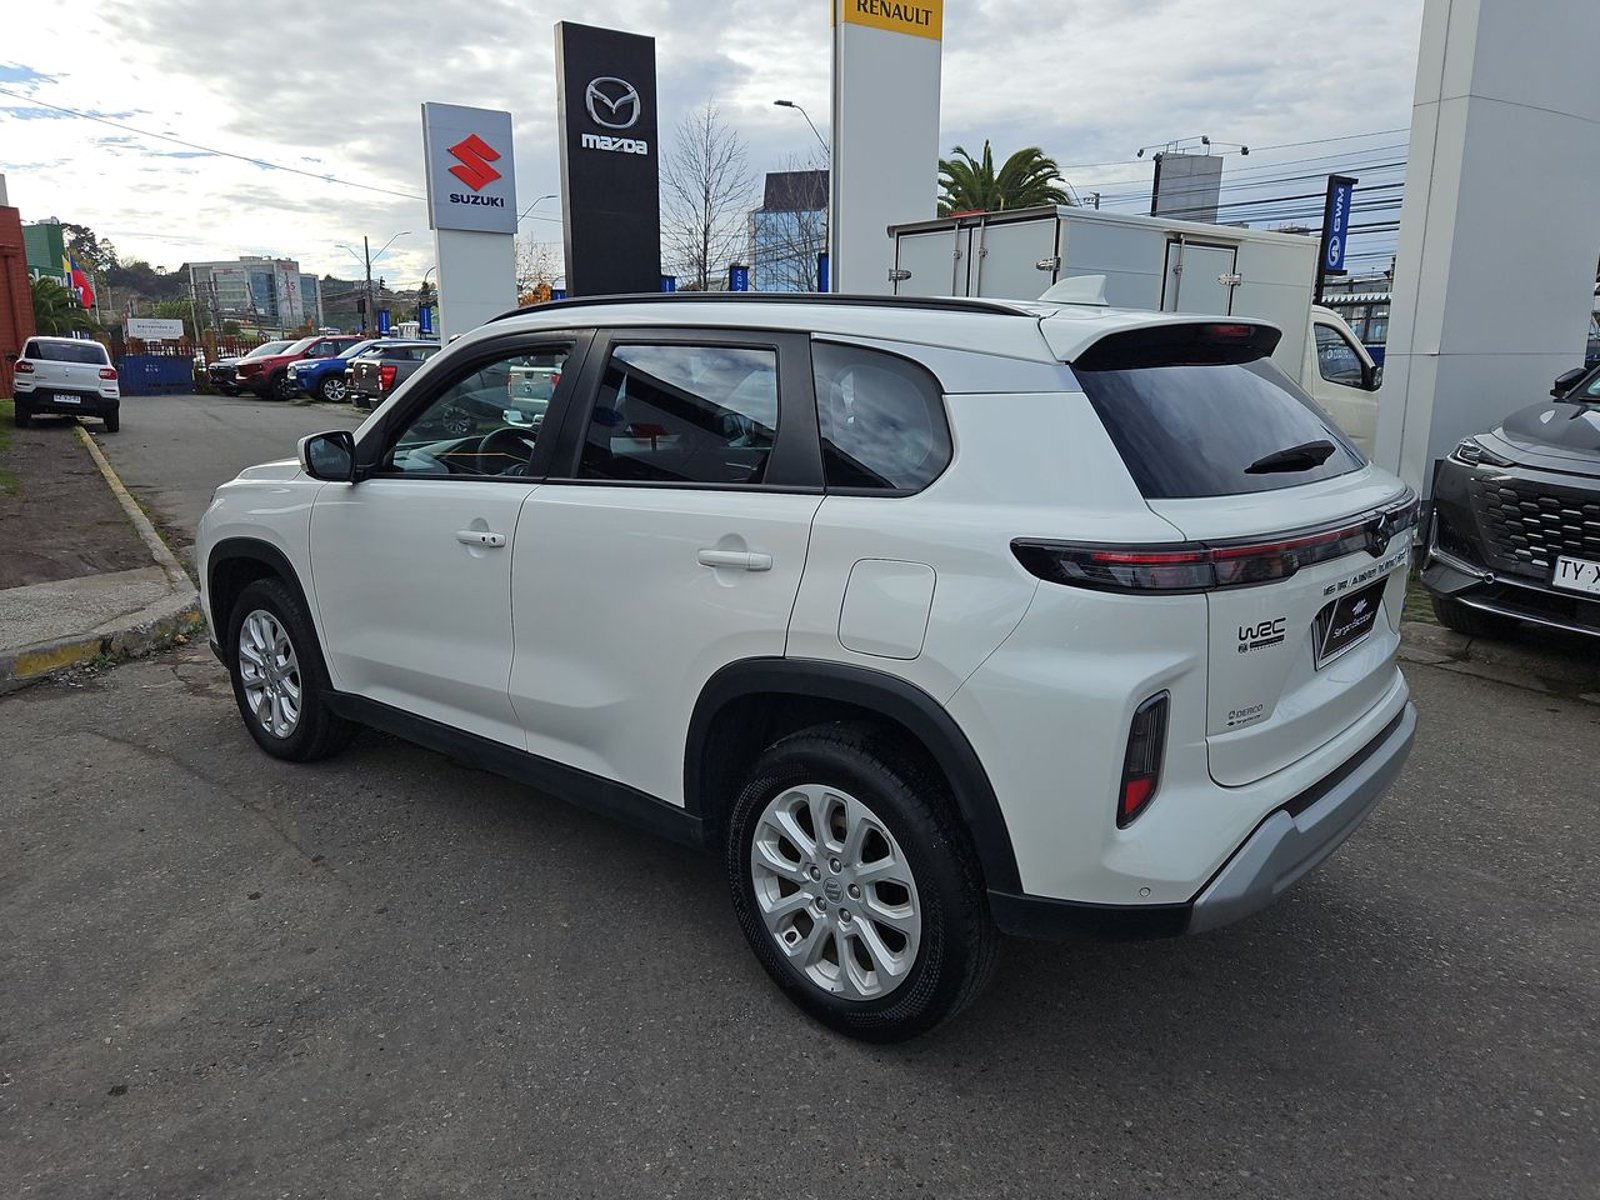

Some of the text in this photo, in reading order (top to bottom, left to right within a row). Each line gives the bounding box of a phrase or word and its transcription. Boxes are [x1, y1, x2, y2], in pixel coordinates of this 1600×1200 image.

[856, 0, 933, 26] RENAULT
[449, 193, 505, 208] SUZUKI
[1333, 187, 1345, 233] GWM
[1238, 617, 1286, 641] WRC
